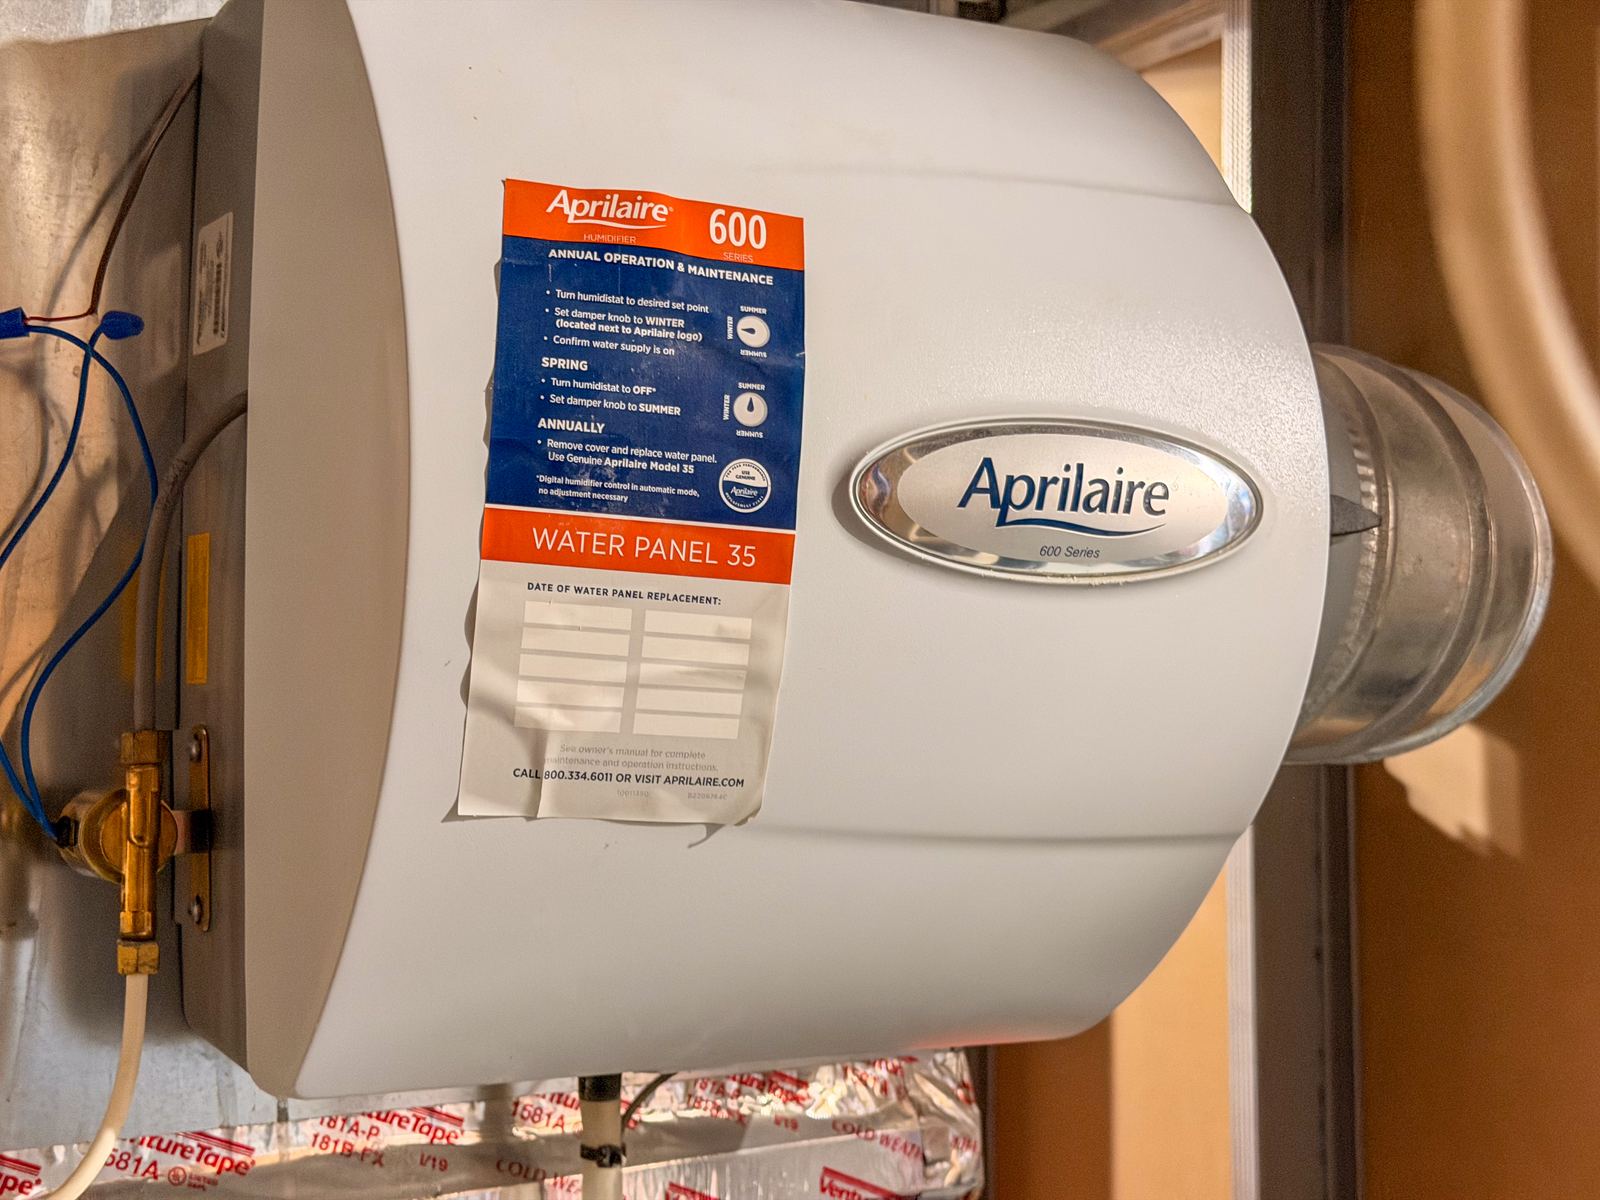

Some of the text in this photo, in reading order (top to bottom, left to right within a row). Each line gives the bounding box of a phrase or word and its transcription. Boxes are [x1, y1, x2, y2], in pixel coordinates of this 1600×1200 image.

[546, 189, 670, 228] Aprilaire
[583, 234, 636, 244] HUMIDIFIER
[709, 209, 767, 250] 600
[548, 249, 774, 286] ANNUAL OPERATION & MAINTENANCE
[723, 252, 754, 263] SERIES
[556, 289, 710, 314] Turn humidistat to desired set point
[740, 306, 767, 315] SUMMER
[554, 307, 685, 328] Set damper knob to WINTER
[556, 318, 703, 342] (located next to Aprilaire logo)
[726, 316, 734, 340] WINTER
[553, 335, 675, 356] Confirm water supply is on
[740, 349, 768, 358] SUMMER
[541, 356, 588, 371] SPRING
[550, 378, 572, 388] Turn
[573, 380, 620, 393] humidistat
[622, 385, 632, 394] to
[738, 382, 766, 391] SUMMER
[550, 394, 681, 416] Set damper knob to SUMMER
[538, 418, 606, 434] ANNUALLY
[736, 430, 764, 438] SUMMER
[547, 438, 718, 464] Remove cover and replace water panel.
[548, 452, 694, 474] Use Genuine Aprilaire Model 35
[550, 488, 591, 500] adjustment
[592, 492, 628, 504] necessary
[565, 478, 603, 489] humidifier
[604, 481, 630, 490] control
[630, 482, 638, 490] in
[640, 484, 676, 495] automatic
[677, 488, 700, 498] mode,
[957, 456, 1170, 530] Aprilaire
[532, 528, 756, 568] WATER PANEL 35
[1038, 545, 1100, 560] 600 Series
[527, 582, 722, 606] DATE OF WATER PANEL REPLACEMENT:
[616, 748, 648, 758] manual
[650, 748, 662, 758] for
[664, 750, 706, 760] complete
[602, 760, 620, 768] and
[622, 760, 664, 770] operation
[513, 768, 744, 788] CALL 800.334.6011 OR VISIT APRILAIRE.COM
